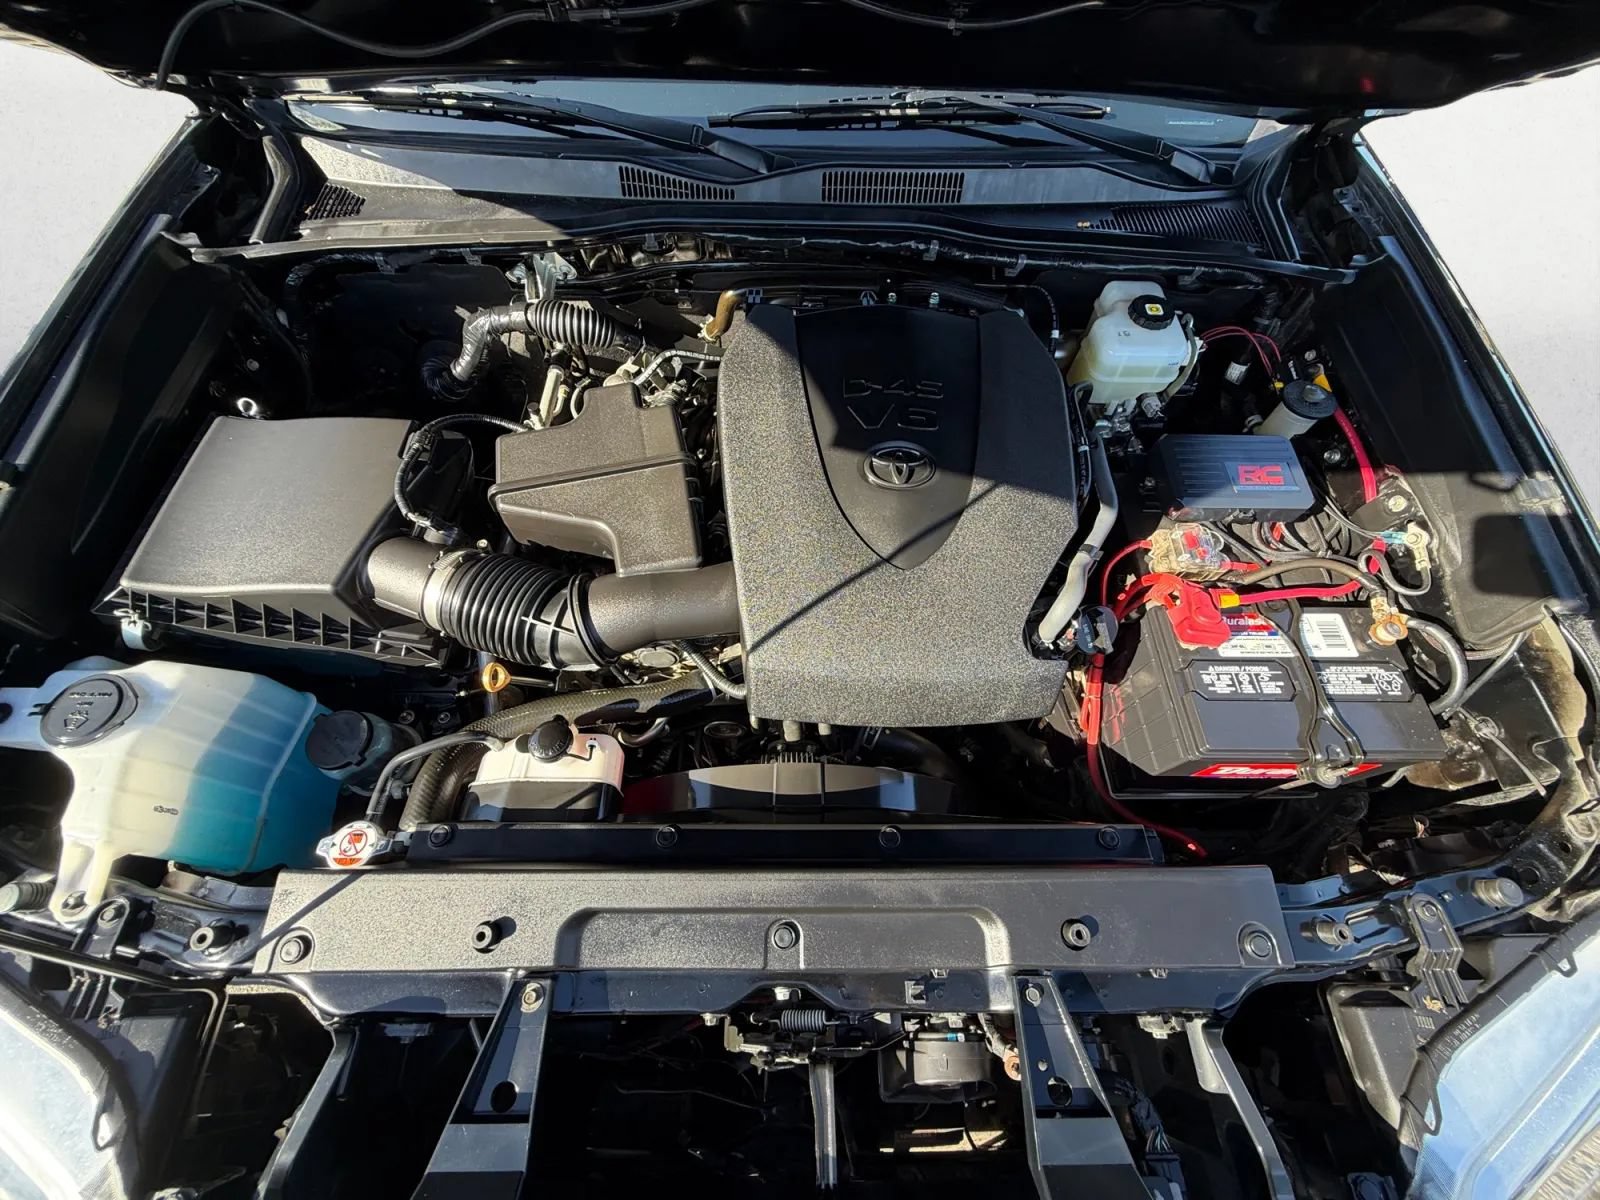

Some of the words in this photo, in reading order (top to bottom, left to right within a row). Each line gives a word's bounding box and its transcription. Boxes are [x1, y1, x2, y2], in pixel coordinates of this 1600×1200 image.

[843, 377, 944, 399] D-4S
[847, 403, 940, 431] V6
[1237, 464, 1285, 485] RC
